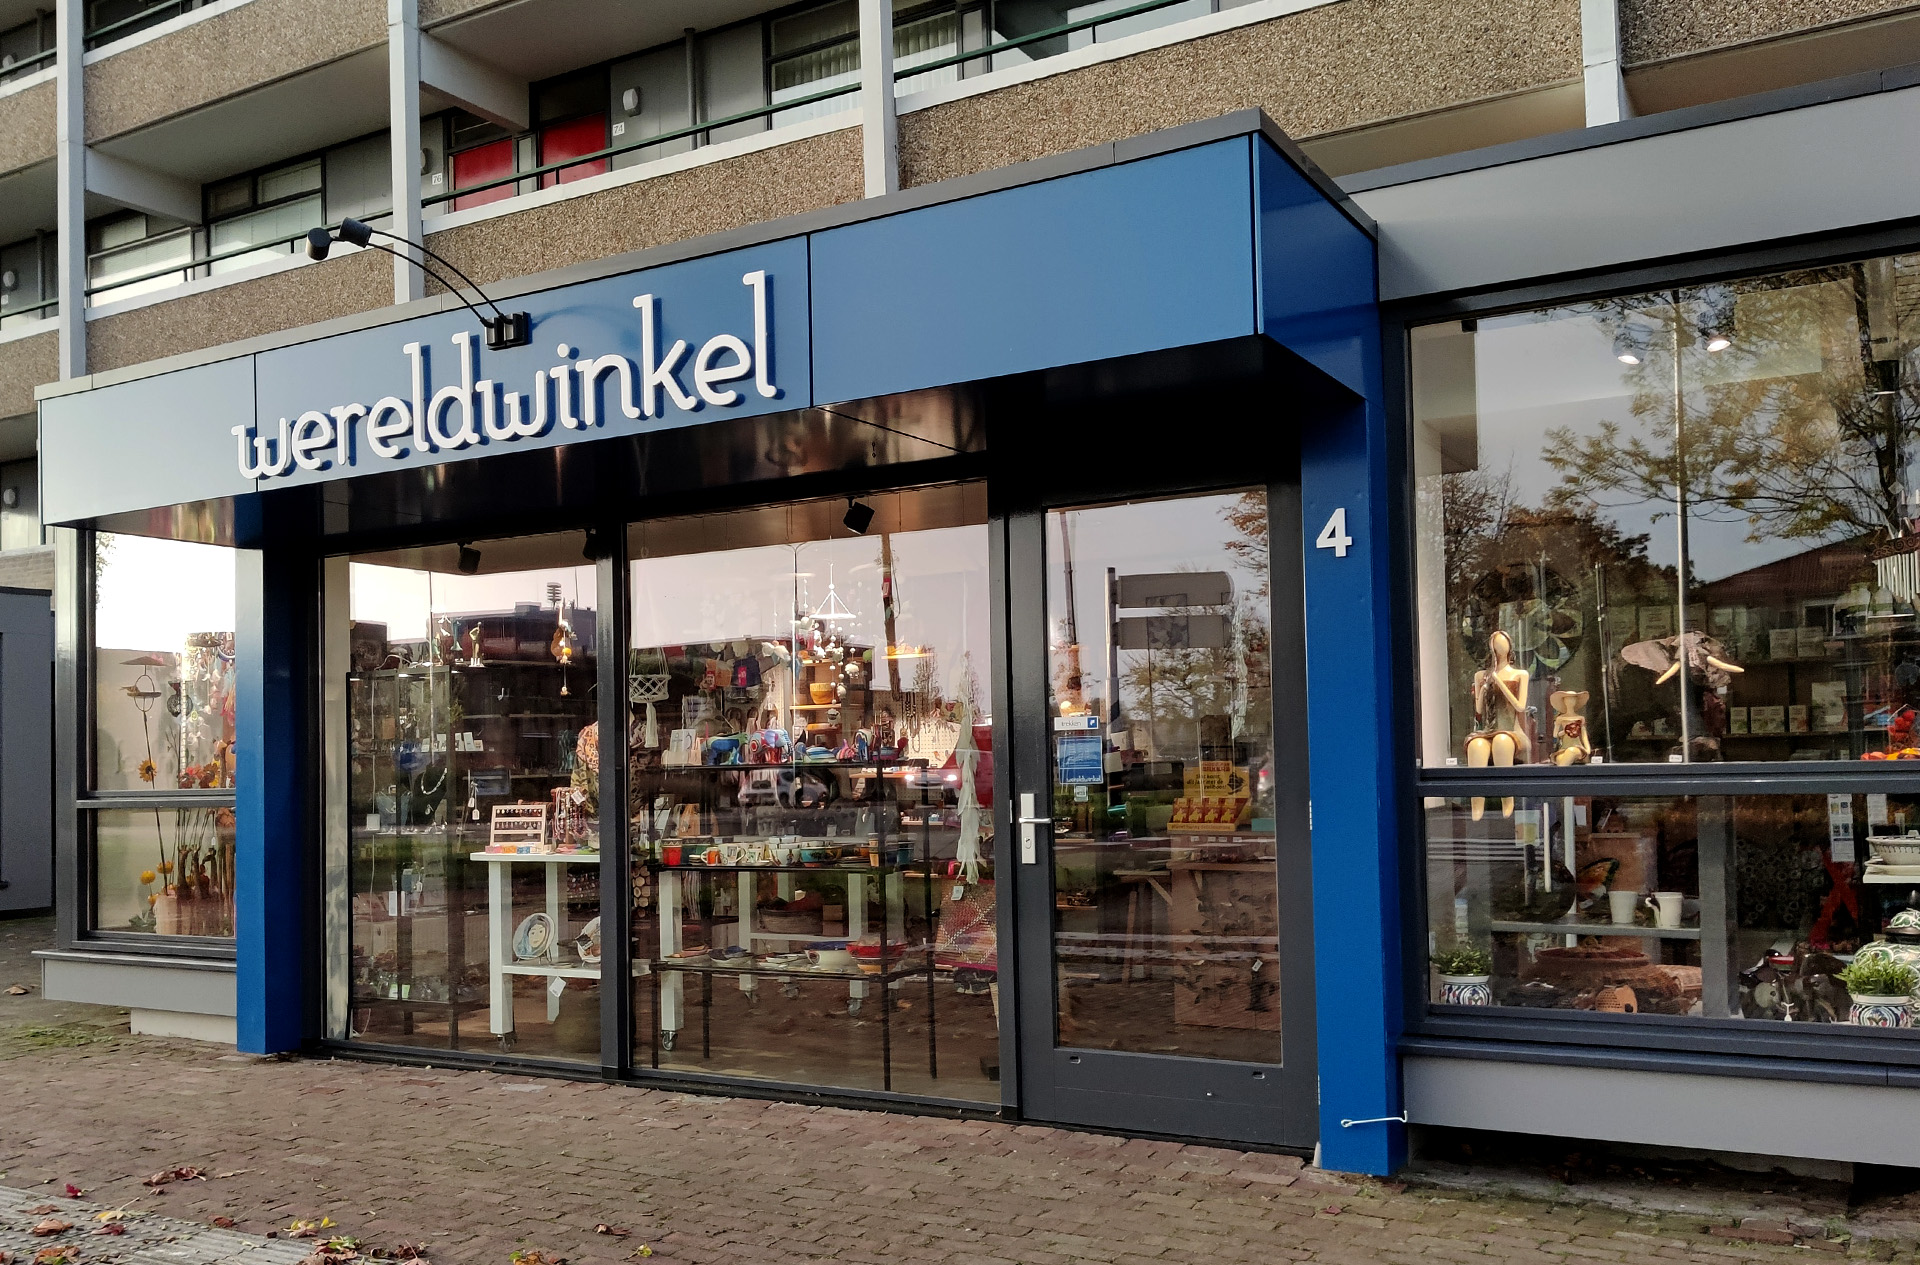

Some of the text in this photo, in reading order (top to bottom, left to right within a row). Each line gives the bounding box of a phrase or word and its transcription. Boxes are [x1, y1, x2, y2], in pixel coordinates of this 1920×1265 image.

[613, 124, 623, 134] 74
[433, 174, 442, 184] 76
[231, 269, 777, 482] wereldwinkel
[1315, 507, 1353, 558] 4
